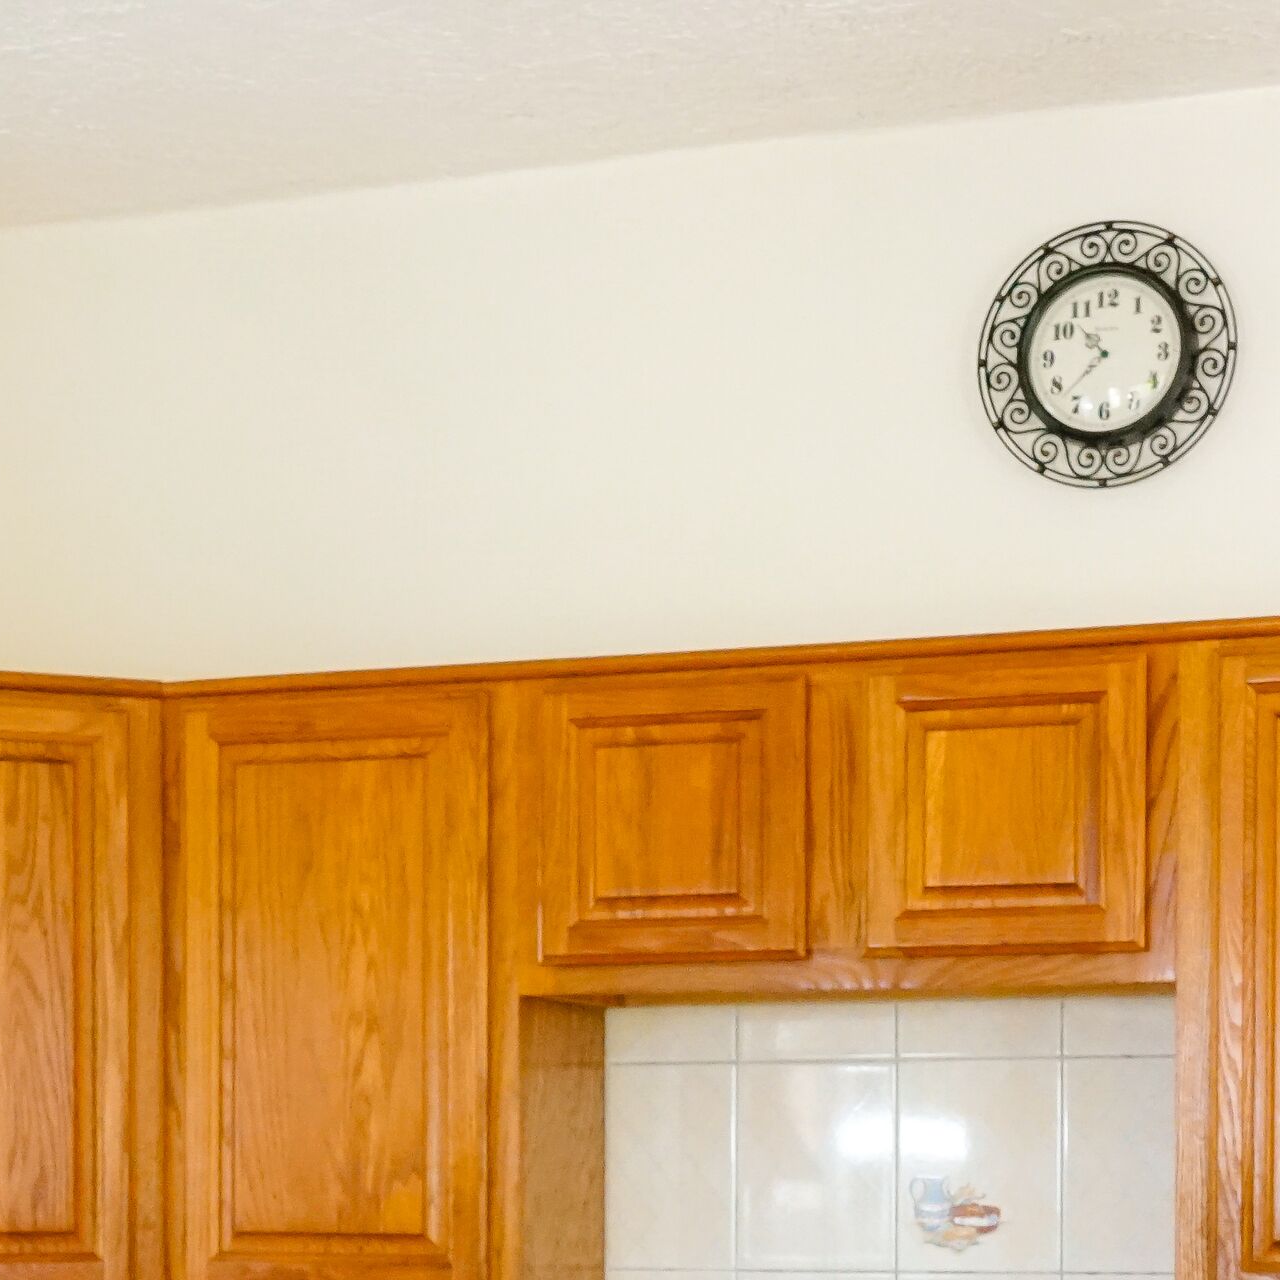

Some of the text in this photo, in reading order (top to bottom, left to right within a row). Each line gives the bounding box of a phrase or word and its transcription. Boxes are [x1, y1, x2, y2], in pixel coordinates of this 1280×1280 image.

[1098, 288, 1119, 308] 12
[1134, 296, 1142, 314] 1
[1072, 300, 1091, 318] 11
[1054, 321, 1074, 341] 10
[1150, 315, 1162, 333] 2
[1042, 349, 1055, 369] 9
[1157, 341, 1169, 361] 3
[1050, 375, 1063, 395] 8
[1071, 395, 1082, 414] 7
[1098, 401, 1110, 421] 6
